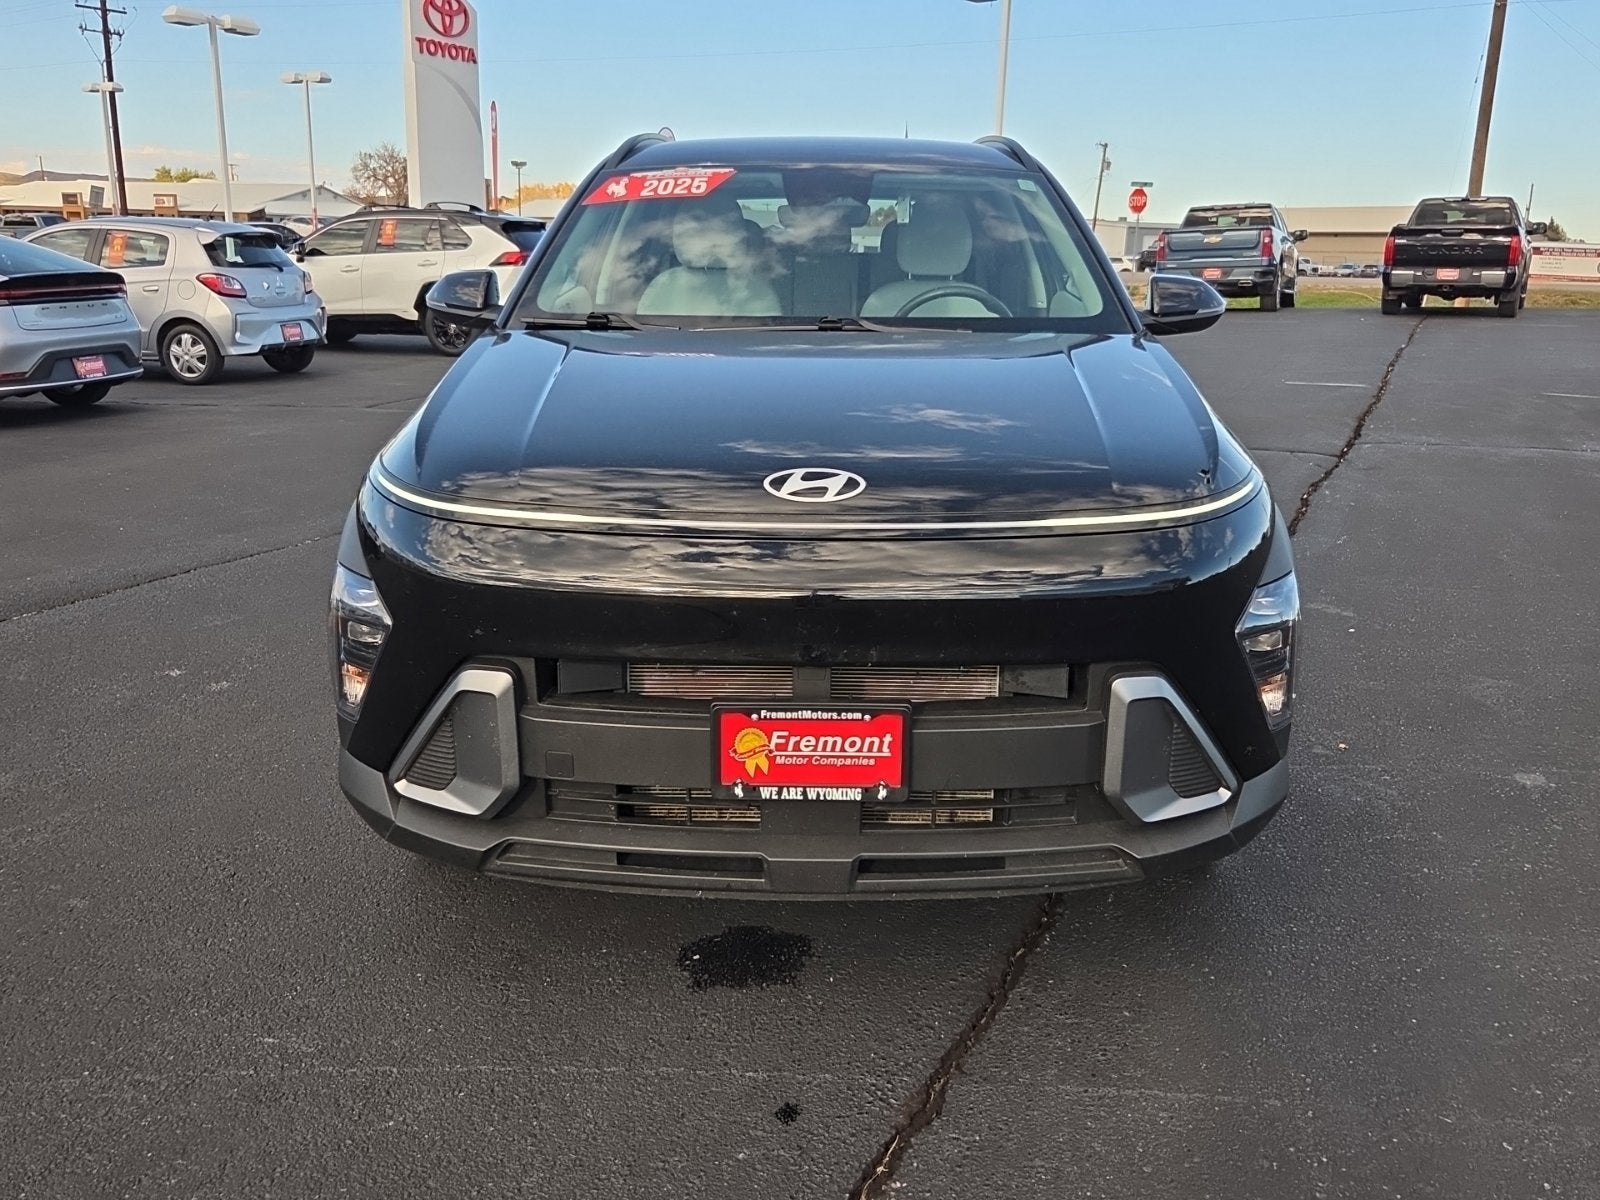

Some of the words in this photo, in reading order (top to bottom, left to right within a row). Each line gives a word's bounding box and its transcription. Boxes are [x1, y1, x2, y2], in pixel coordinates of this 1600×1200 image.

[415, 36, 478, 65] TOYOTA
[640, 177, 708, 197] 2025
[1129, 196, 1147, 207] STOP
[1417, 246, 1484, 255] TUNDRA
[760, 709, 863, 720] FremontMotors.com
[770, 731, 893, 753] Fremont
[775, 756, 809, 766] Motor
[811, 756, 876, 767] Companies
[760, 787, 779, 800] WE
[781, 787, 803, 800] ARE
[806, 787, 862, 801] WYOMING
